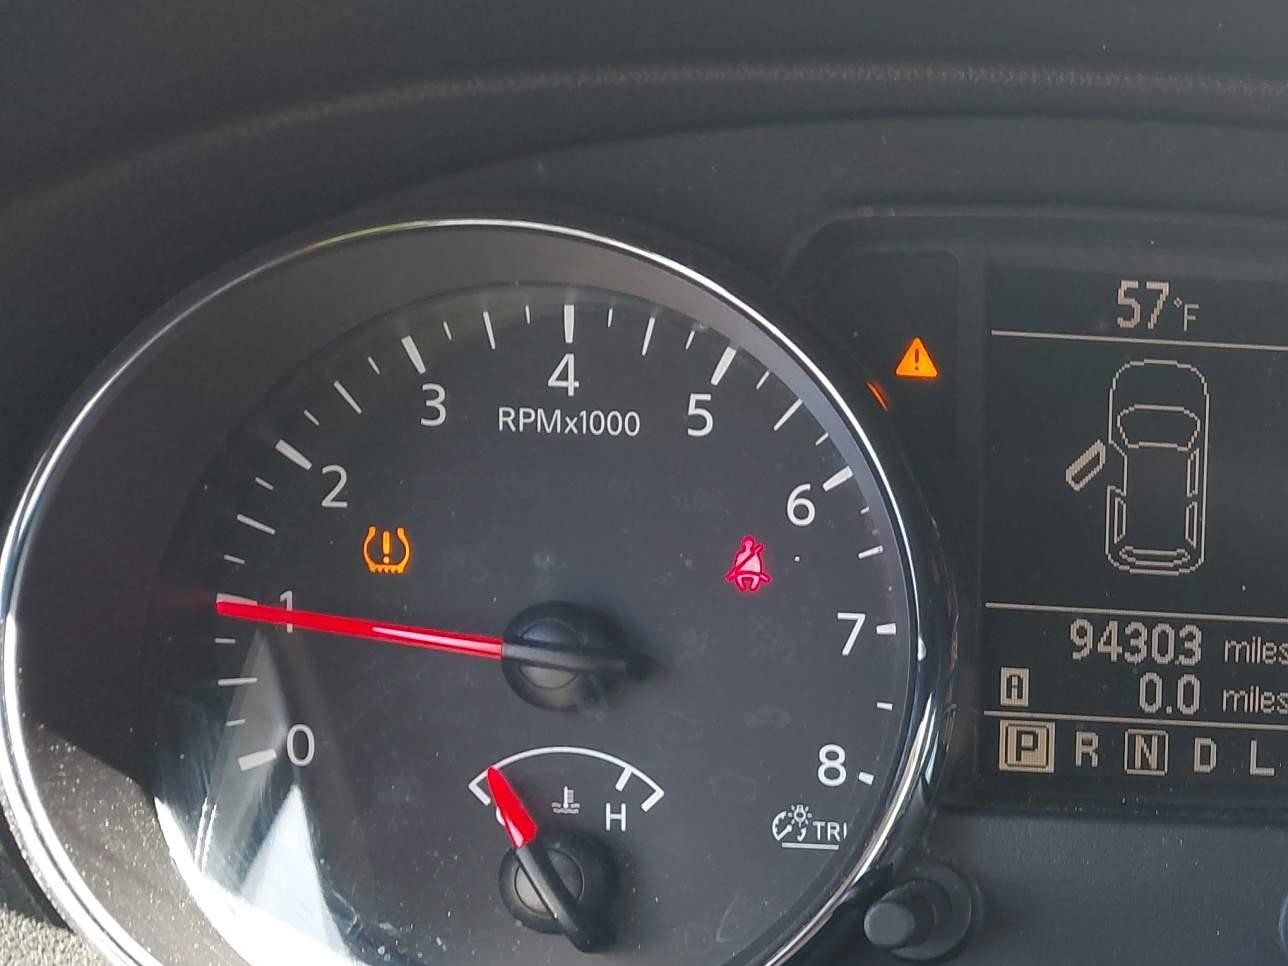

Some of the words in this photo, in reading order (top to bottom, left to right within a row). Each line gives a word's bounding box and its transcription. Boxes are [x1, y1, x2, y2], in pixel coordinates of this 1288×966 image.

[547, 353, 580, 397] 4
[420, 383, 447, 426] 3
[498, 407, 641, 437] RPMx1000
[687, 393, 714, 437] 5
[321, 464, 348, 508] 2
[787, 483, 816, 526] 6
[279, 589, 294, 634] 1
[837, 612, 866, 656] 7
[1070, 618, 1202, 666] 94303
[1139, 672, 1201, 715] 0.0
[286, 724, 315, 766] 0
[817, 744, 847, 787] 8
[1075, 731, 1099, 767] R
[1134, 734, 1159, 770] N
[1193, 737, 1217, 773] D
[1249, 740, 1275, 776] L
[605, 802, 627, 832] H
